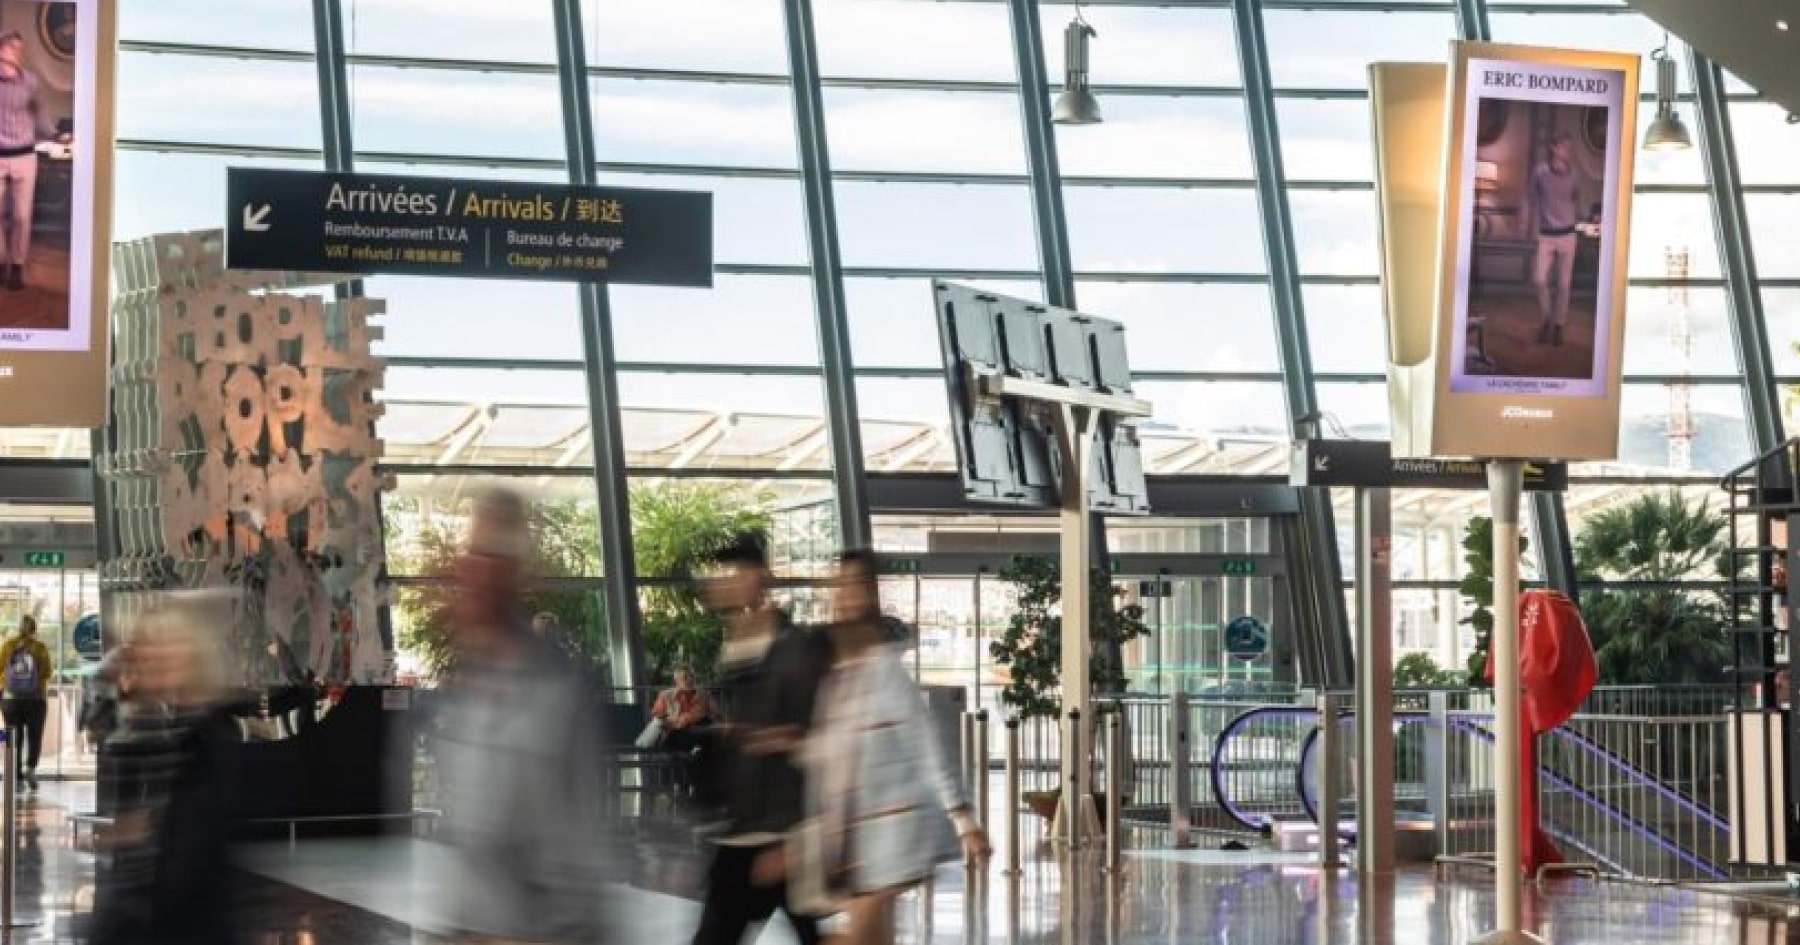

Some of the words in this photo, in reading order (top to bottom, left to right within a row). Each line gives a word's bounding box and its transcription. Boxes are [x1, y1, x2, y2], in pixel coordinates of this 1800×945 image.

[1483, 70, 1523, 87] ERIC
[1527, 74, 1608, 93] BOMPARD
[325, 181, 438, 215] Arrivées
[445, 188, 457, 215] /
[463, 190, 554, 221] Arrivals
[561, 197, 570, 221] /
[576, 199, 623, 222] 到达
[325, 221, 433, 240] Remboursement
[507, 230, 553, 246] Bureau
[556, 232, 572, 247] de
[576, 232, 623, 252] change
[352, 245, 393, 261] refund
[507, 252, 553, 270] Change
